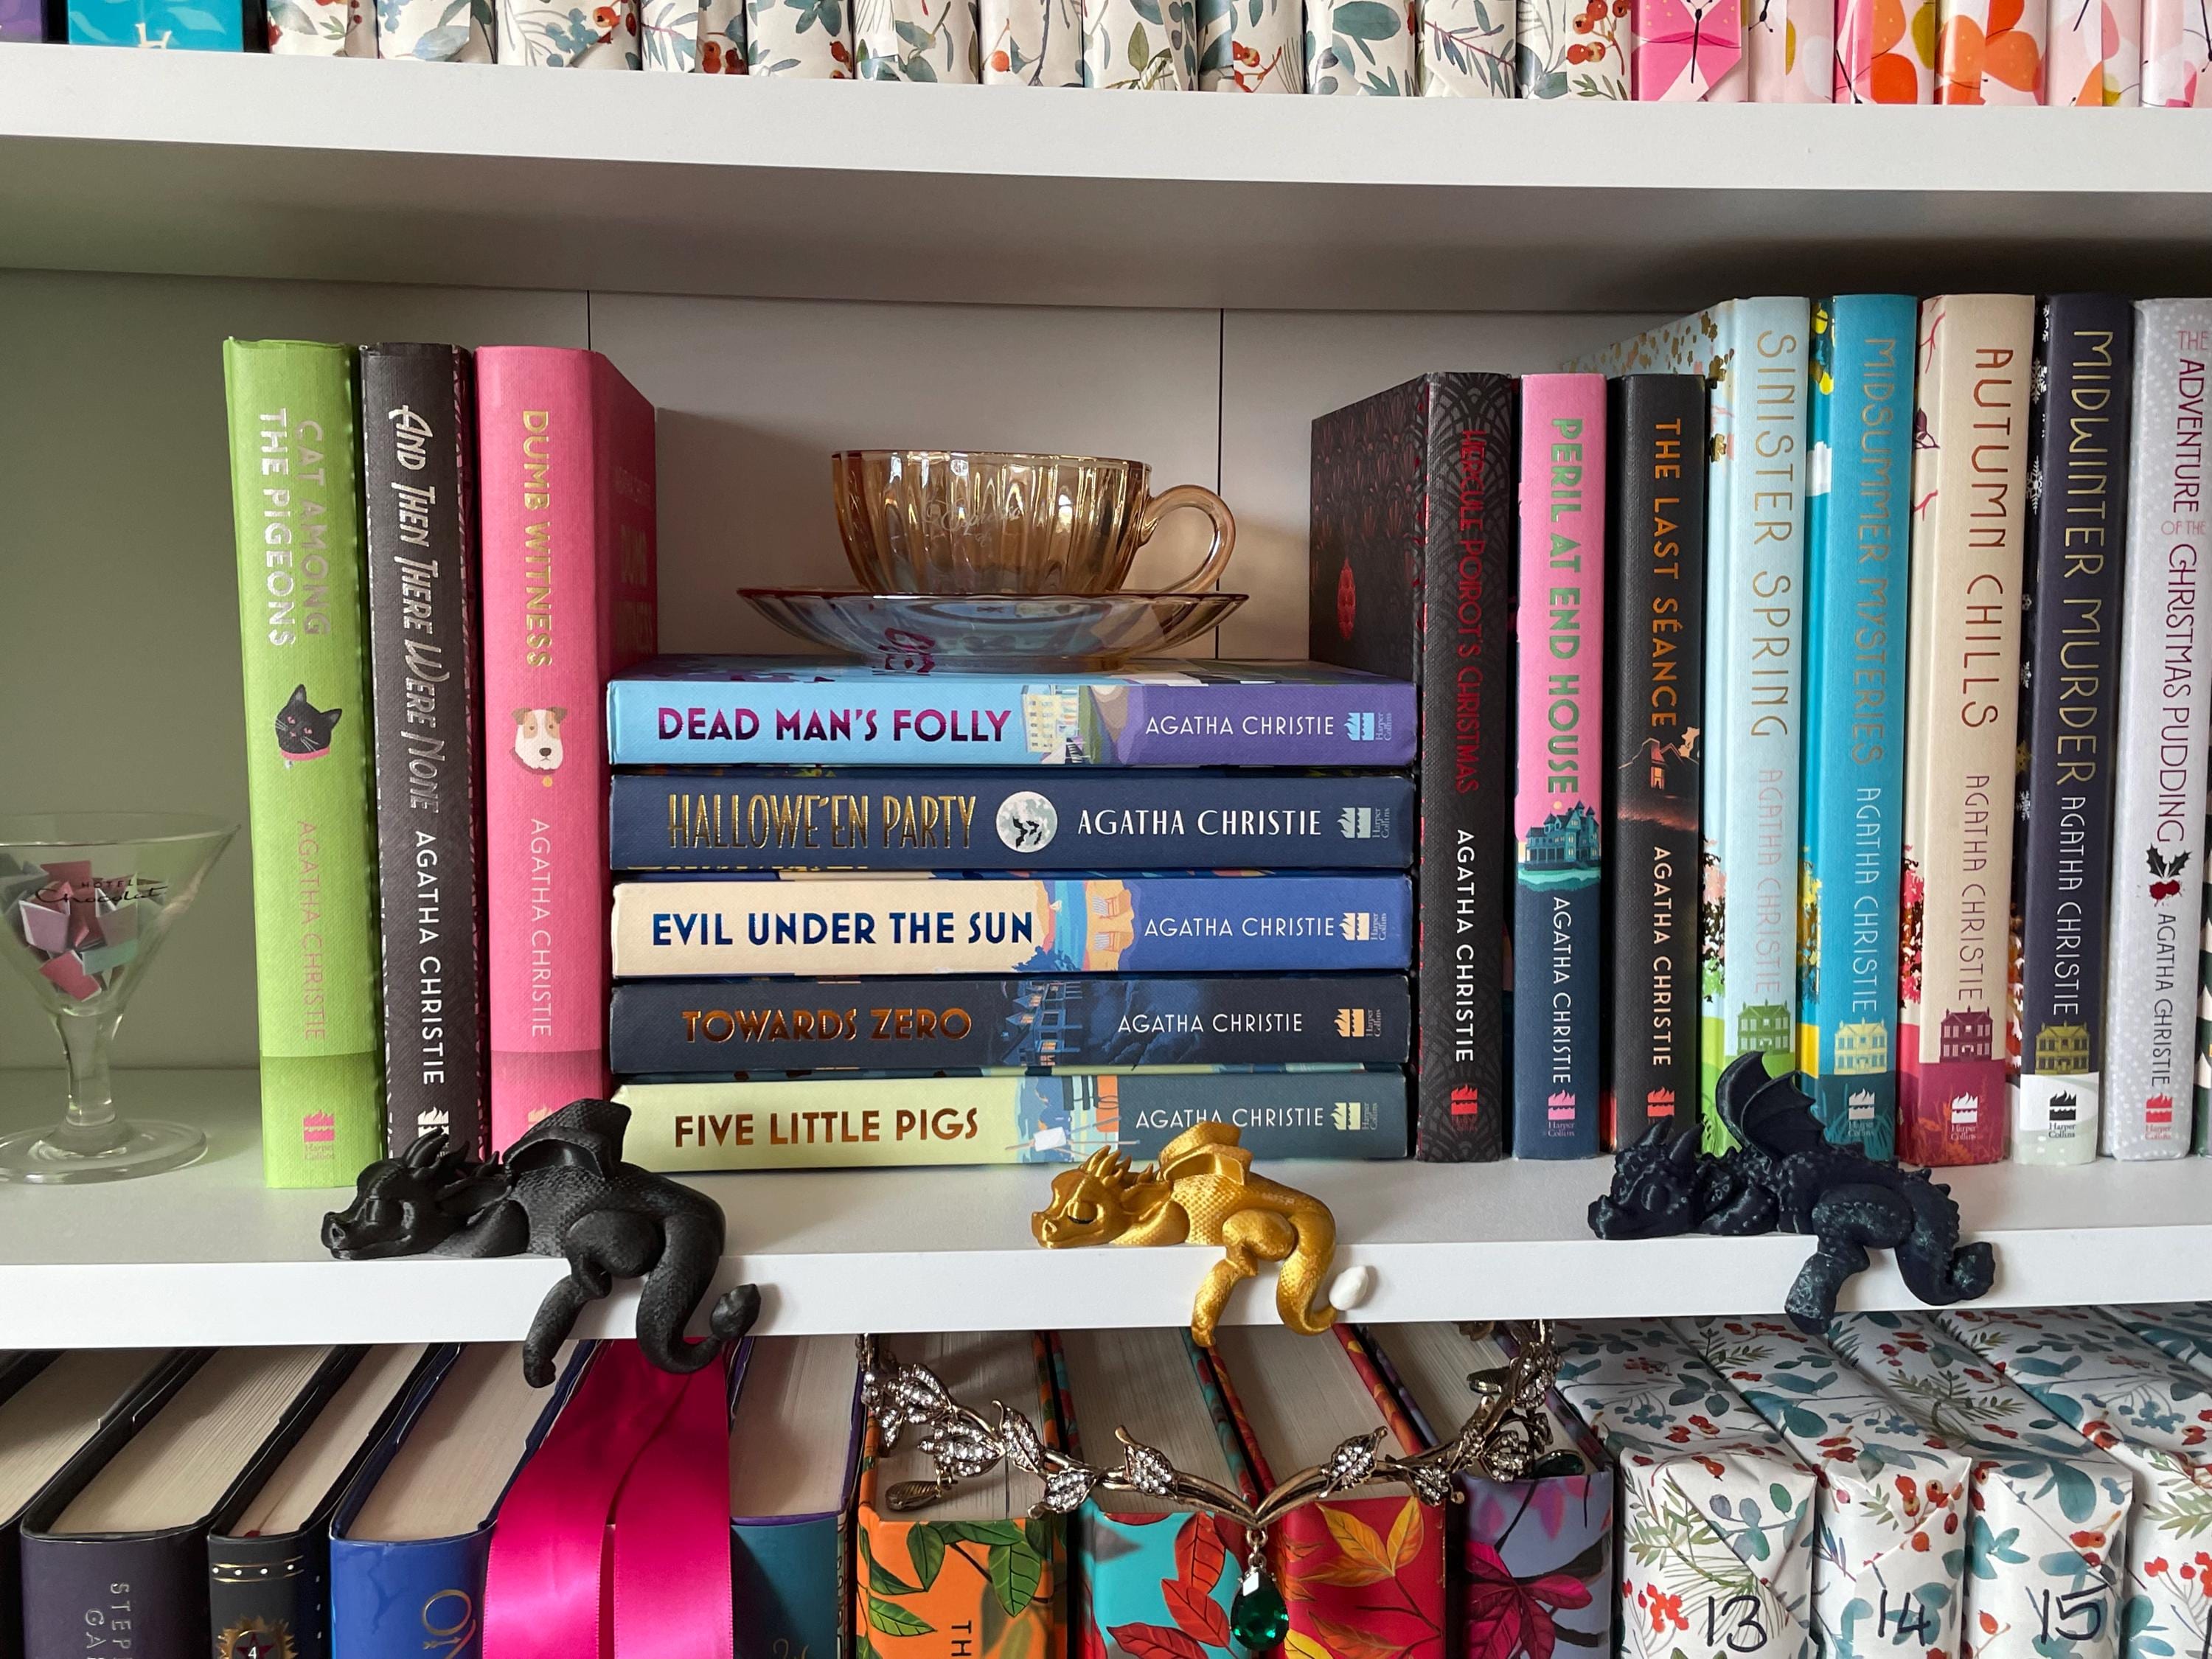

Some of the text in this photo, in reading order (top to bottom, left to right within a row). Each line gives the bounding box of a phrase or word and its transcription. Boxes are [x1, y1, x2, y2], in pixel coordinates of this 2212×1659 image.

[2178, 330, 2207, 350] THE
[1458, 428, 1486, 532] HERCULE
[2173, 358, 2205, 513] ADVENTURE
[258, 408, 296, 646] THE PIGEONS
[294, 420, 332, 636] CAT AMONG
[521, 410, 553, 667] DUMB WITNESS
[1651, 418, 1683, 727] THE LAST SÉANCE
[1750, 330, 1796, 737] SINISTER SPRING
[1853, 339, 1896, 765] MIDSUMMER MYSTERIES
[1961, 349, 2013, 728] AUTUMN CHILLS
[2056, 330, 2114, 786] MIDWINTER MURDER
[2161, 521, 2206, 535] OF THE
[1548, 418, 1583, 793] PERIL AT END HOUSE
[658, 707, 1012, 741] DEAD MAN'S FOLLY
[1146, 716, 1334, 736] AGATHA CHRISTIE
[1455, 667, 1482, 793] CHRISTMAS
[2157, 543, 2197, 842] CHRISTMAS PUDDING
[667, 793, 976, 849] HALLOWE'EN PARTY
[1078, 810, 1321, 835] AGATHA CHRISTIE
[1371, 808, 1380, 838] Harper
[1756, 770, 1783, 993] AGATHA CHRISTIE
[298, 821, 326, 1040] AGATHA CHRISTIE
[530, 818, 552, 1037] AGATHA CHRISTIE
[653, 911, 1032, 946] EVIL UNDER THE SUN
[1144, 918, 1334, 937] AGATHA CHRISTIE
[1370, 913, 1379, 940] Harper
[1456, 829, 1475, 1062] AGATHA CHRISTIE
[1852, 787, 1881, 1013] AGATHA CHRISTIE
[1958, 775, 1989, 1001] AGATHA CHRISTIE
[2053, 796, 2085, 1015] AGATHA CHRISTIE
[414, 830, 445, 1085] AGATHA CHRISTIE
[1553, 896, 1572, 1084] AGATHA CHRISTIE
[1652, 846, 1672, 1065] AGATHA CHRISTIE
[2151, 913, 2177, 1086] AGATHA CHRISTIE
[682, 1008, 972, 1042] TOWARDS ZERO
[1118, 1014, 1302, 1032] AGATHA CHRISTIE
[675, 1107, 977, 1147] FIVE LITTLE PIGS
[1135, 1108, 1324, 1129] AGATHA CHRISTIE
[2049, 1123, 2076, 1131] Harper
[2049, 1130, 2076, 1138] Collins
[86, 1609, 106, 1659] GA
[111, 1582, 131, 1659] STEP
[1707, 1594, 1767, 1652] 13
[1877, 1589, 1930, 1646] 14
[2039, 1583, 2112, 1642] 15
